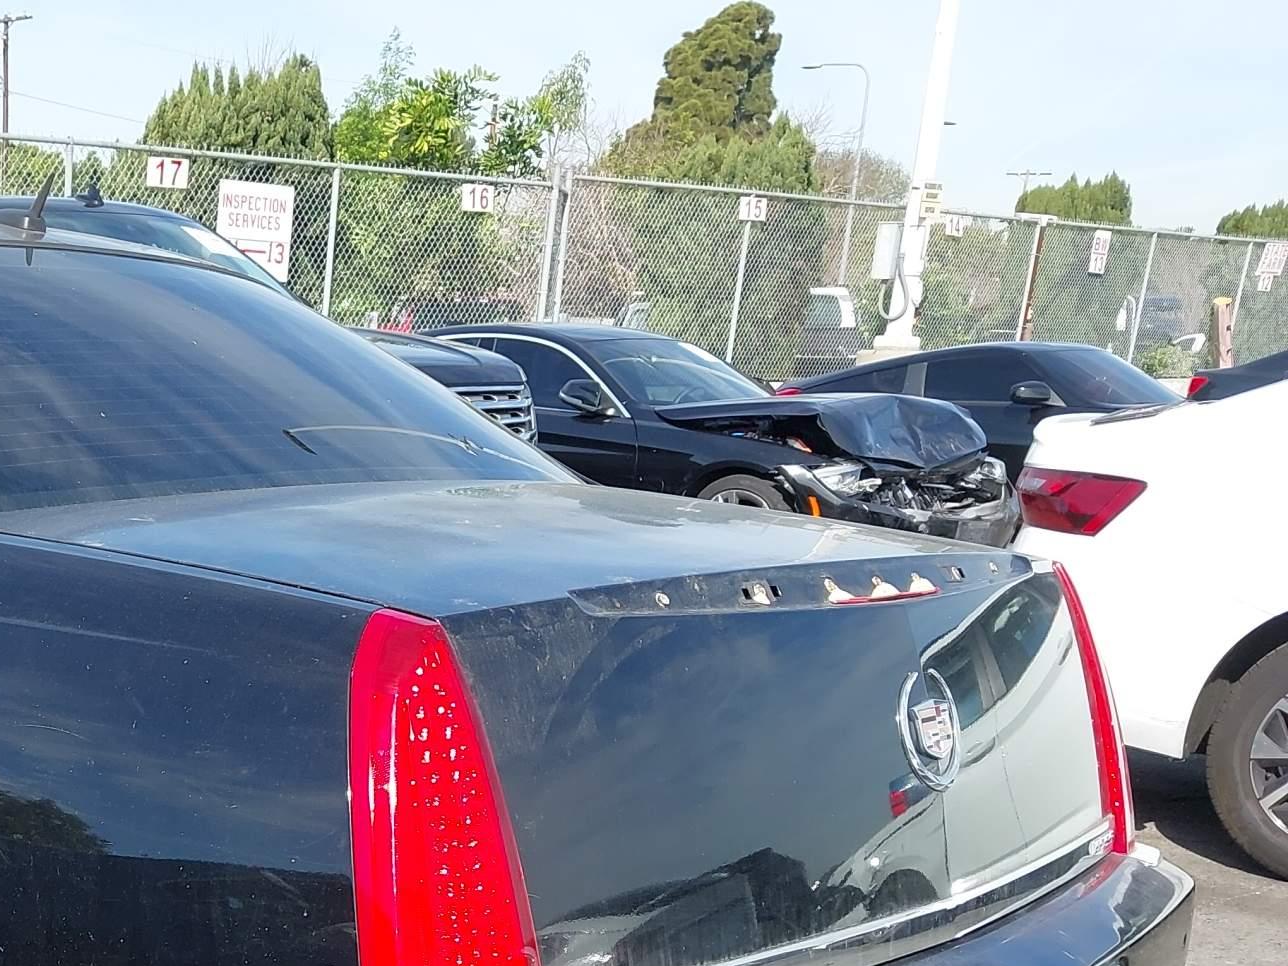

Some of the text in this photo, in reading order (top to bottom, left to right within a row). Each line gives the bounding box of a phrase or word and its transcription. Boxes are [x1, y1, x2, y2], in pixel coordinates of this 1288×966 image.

[156, 159, 183, 185] 17
[222, 193, 287, 213] INSPECTION
[469, 186, 489, 210] 16
[746, 199, 762, 218] 15
[228, 211, 281, 231] SERVICES
[950, 216, 960, 235] 14
[267, 241, 285, 264] 13
